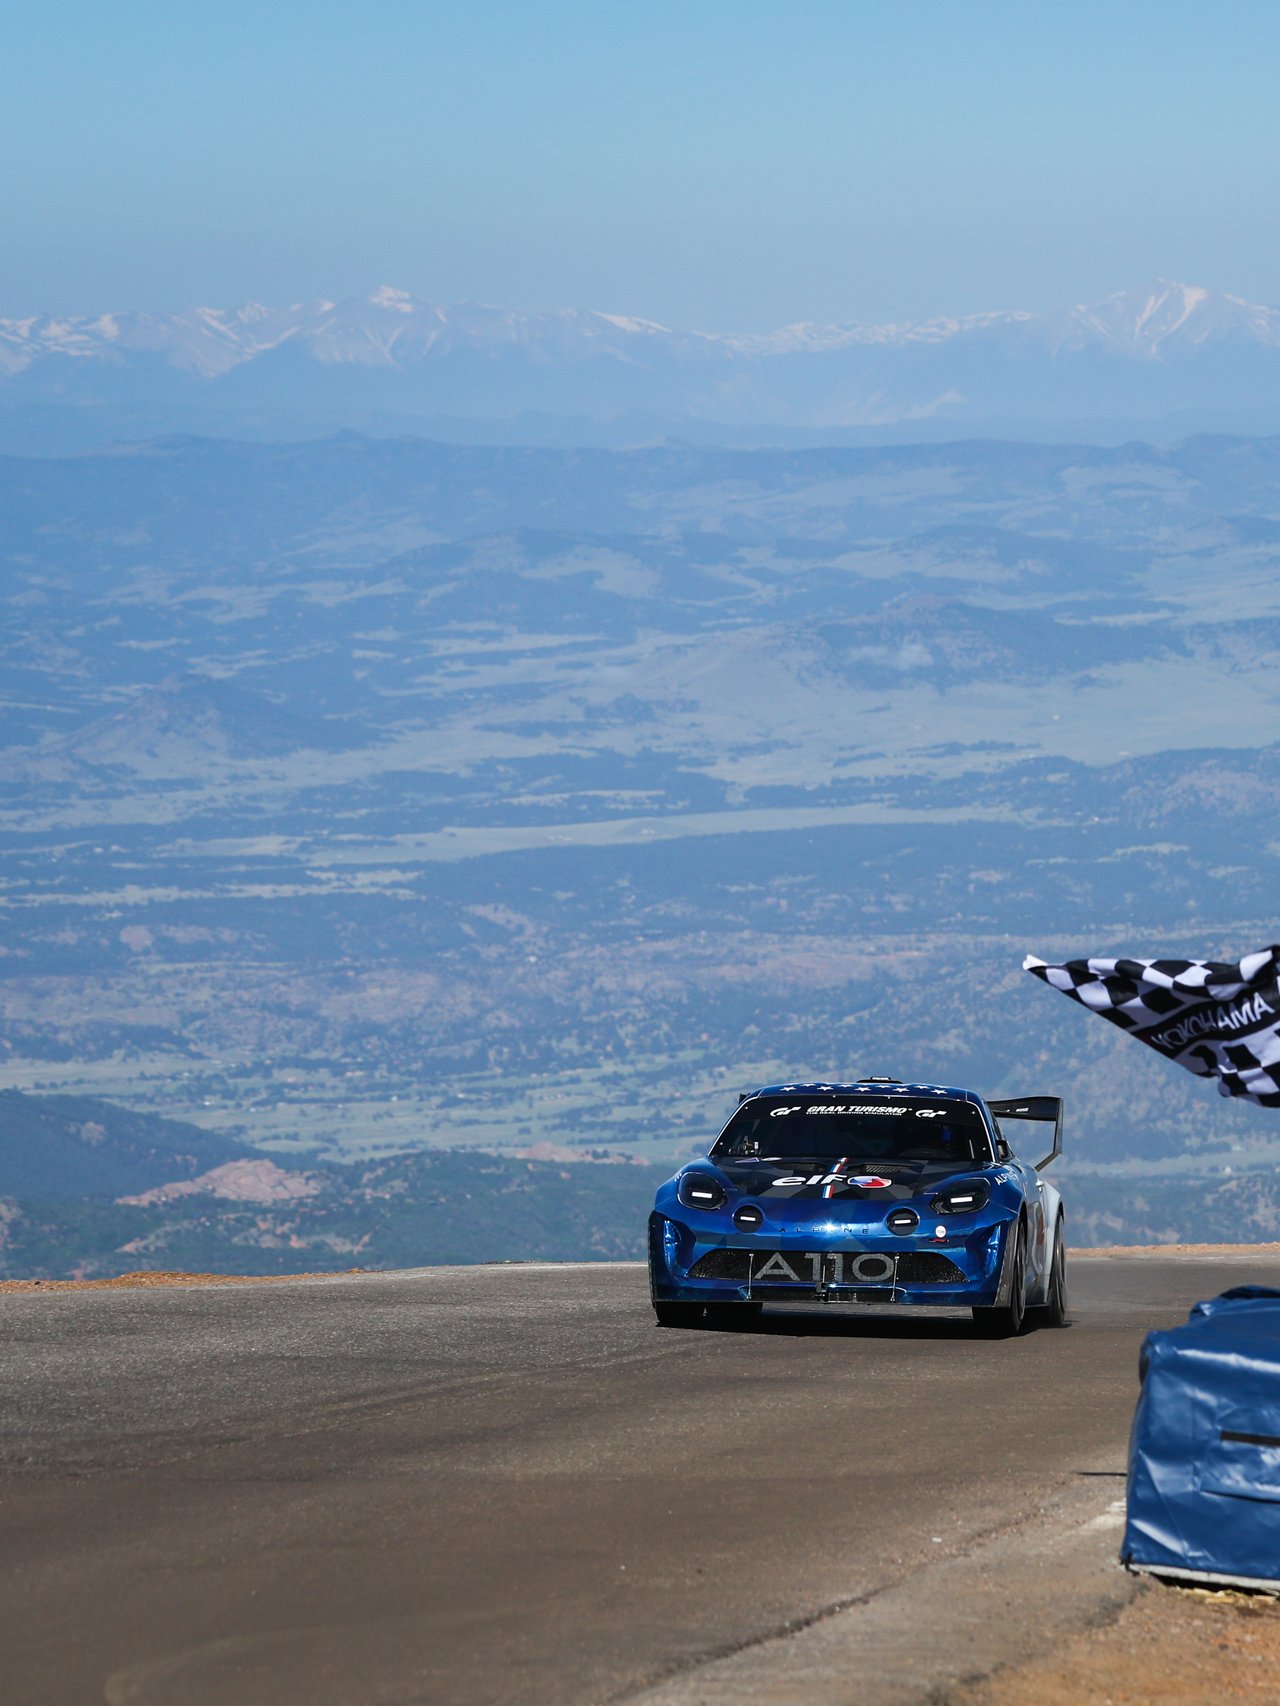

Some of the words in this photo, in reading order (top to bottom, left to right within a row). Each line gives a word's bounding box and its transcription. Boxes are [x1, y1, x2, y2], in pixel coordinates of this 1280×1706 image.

[1151, 992, 1275, 1049] YOKOHAMA
[848, 1105, 908, 1114] TURISMO
[771, 1174, 848, 1187] elf
[754, 1252, 895, 1282] A110
